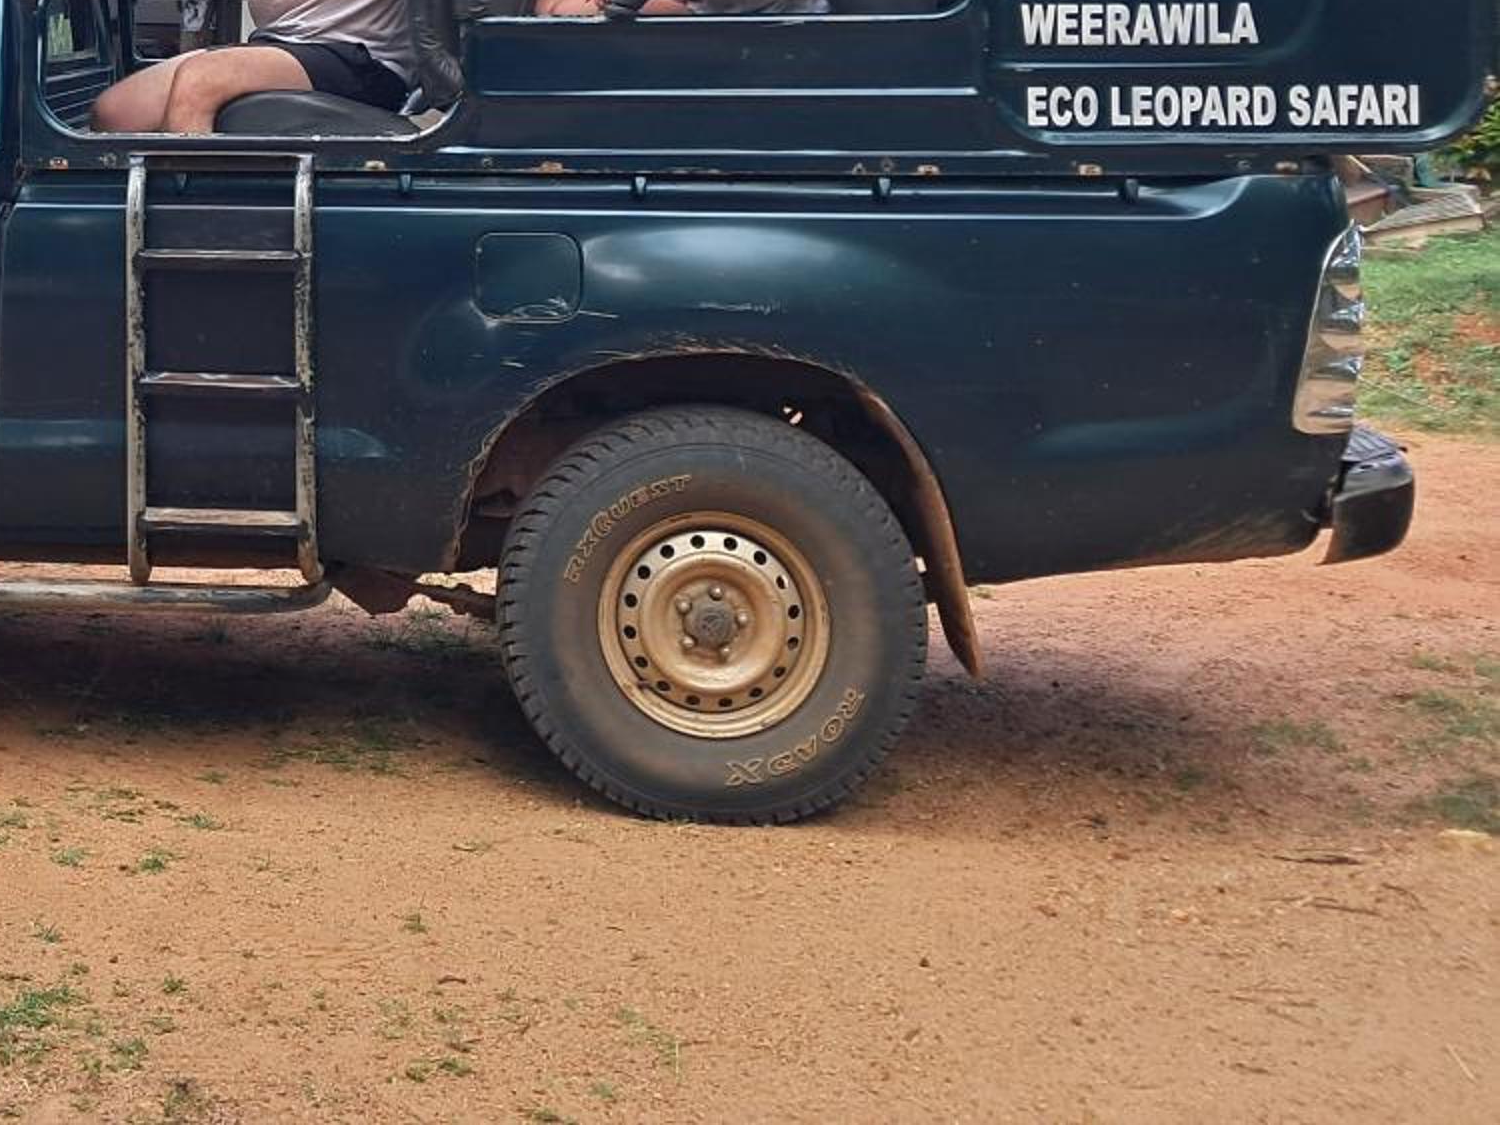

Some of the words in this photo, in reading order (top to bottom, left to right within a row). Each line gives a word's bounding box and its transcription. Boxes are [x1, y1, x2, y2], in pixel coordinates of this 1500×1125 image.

[1020, 1, 1260, 47] WEERAWILA
[1026, 85, 1099, 128] ECO
[1110, 84, 1278, 128] LEOPARD
[1288, 83, 1420, 127] SAFARI
